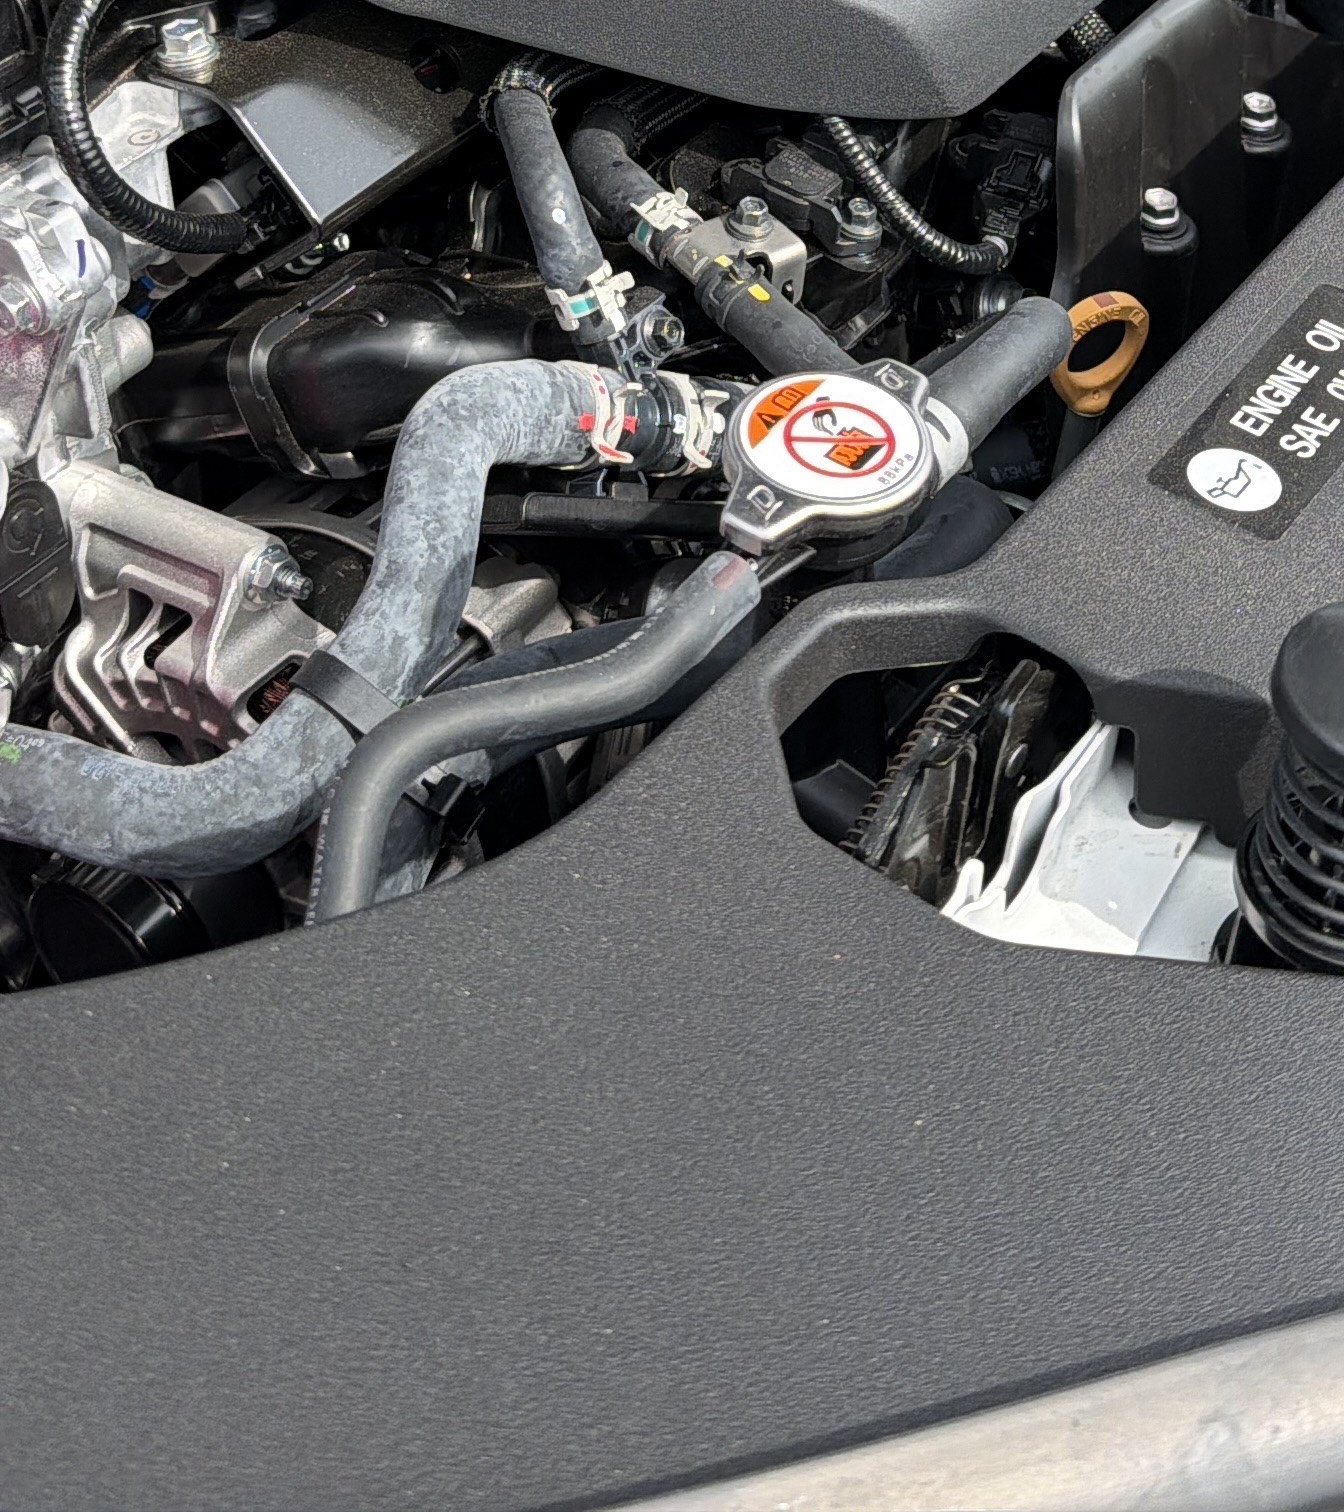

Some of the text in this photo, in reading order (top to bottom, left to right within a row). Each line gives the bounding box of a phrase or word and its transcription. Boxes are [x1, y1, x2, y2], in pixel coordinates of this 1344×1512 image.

[1229, 353, 1321, 437] ENGINE
[1278, 406, 1341, 459] SAE
[877, 452, 914, 486] 88kPa
